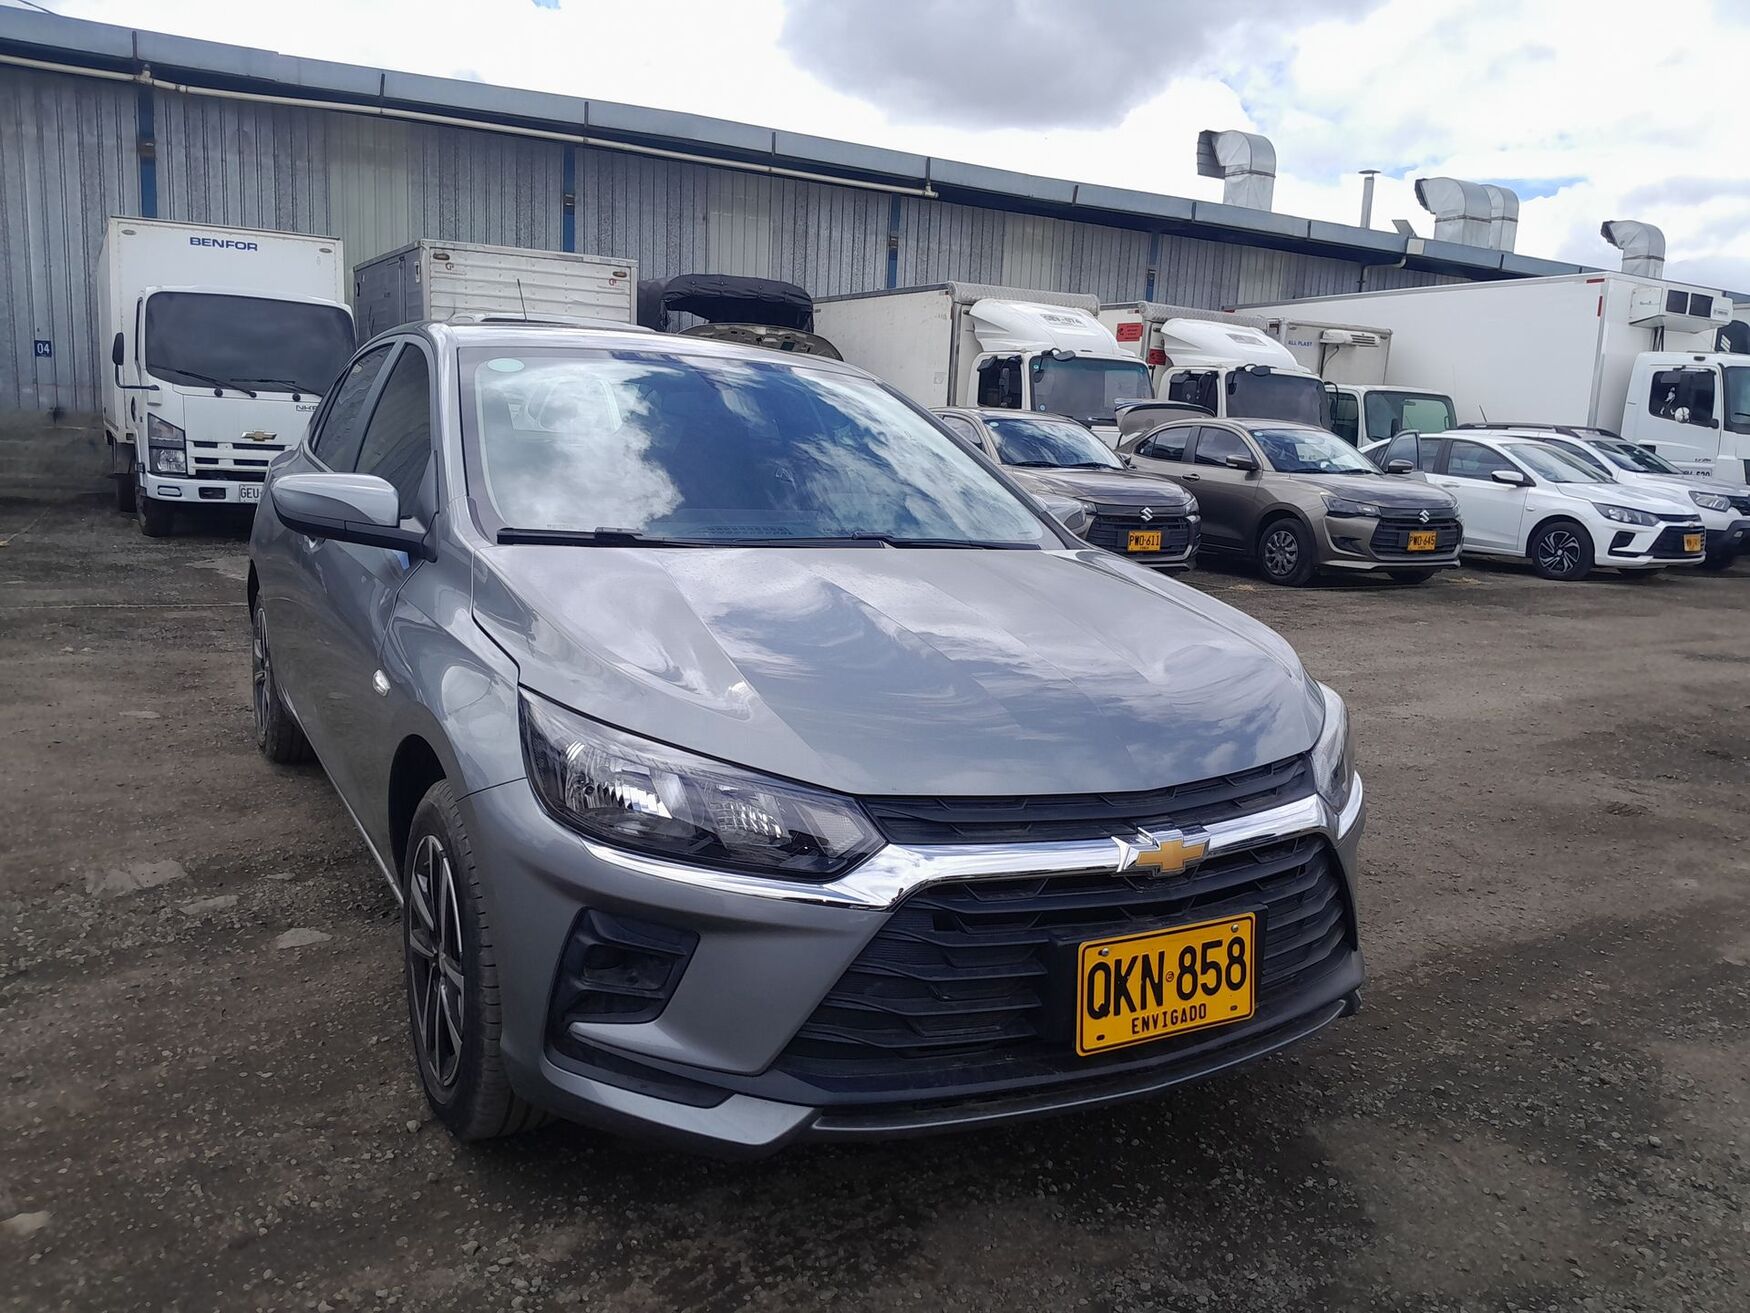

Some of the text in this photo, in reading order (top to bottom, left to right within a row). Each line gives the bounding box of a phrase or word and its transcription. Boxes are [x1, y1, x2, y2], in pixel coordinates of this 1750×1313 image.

[189, 236, 258, 252] BENFOR
[37, 342, 50, 354] 04
[240, 487, 260, 499] GEU
[1131, 1003, 1207, 1035] ENVIGADO
